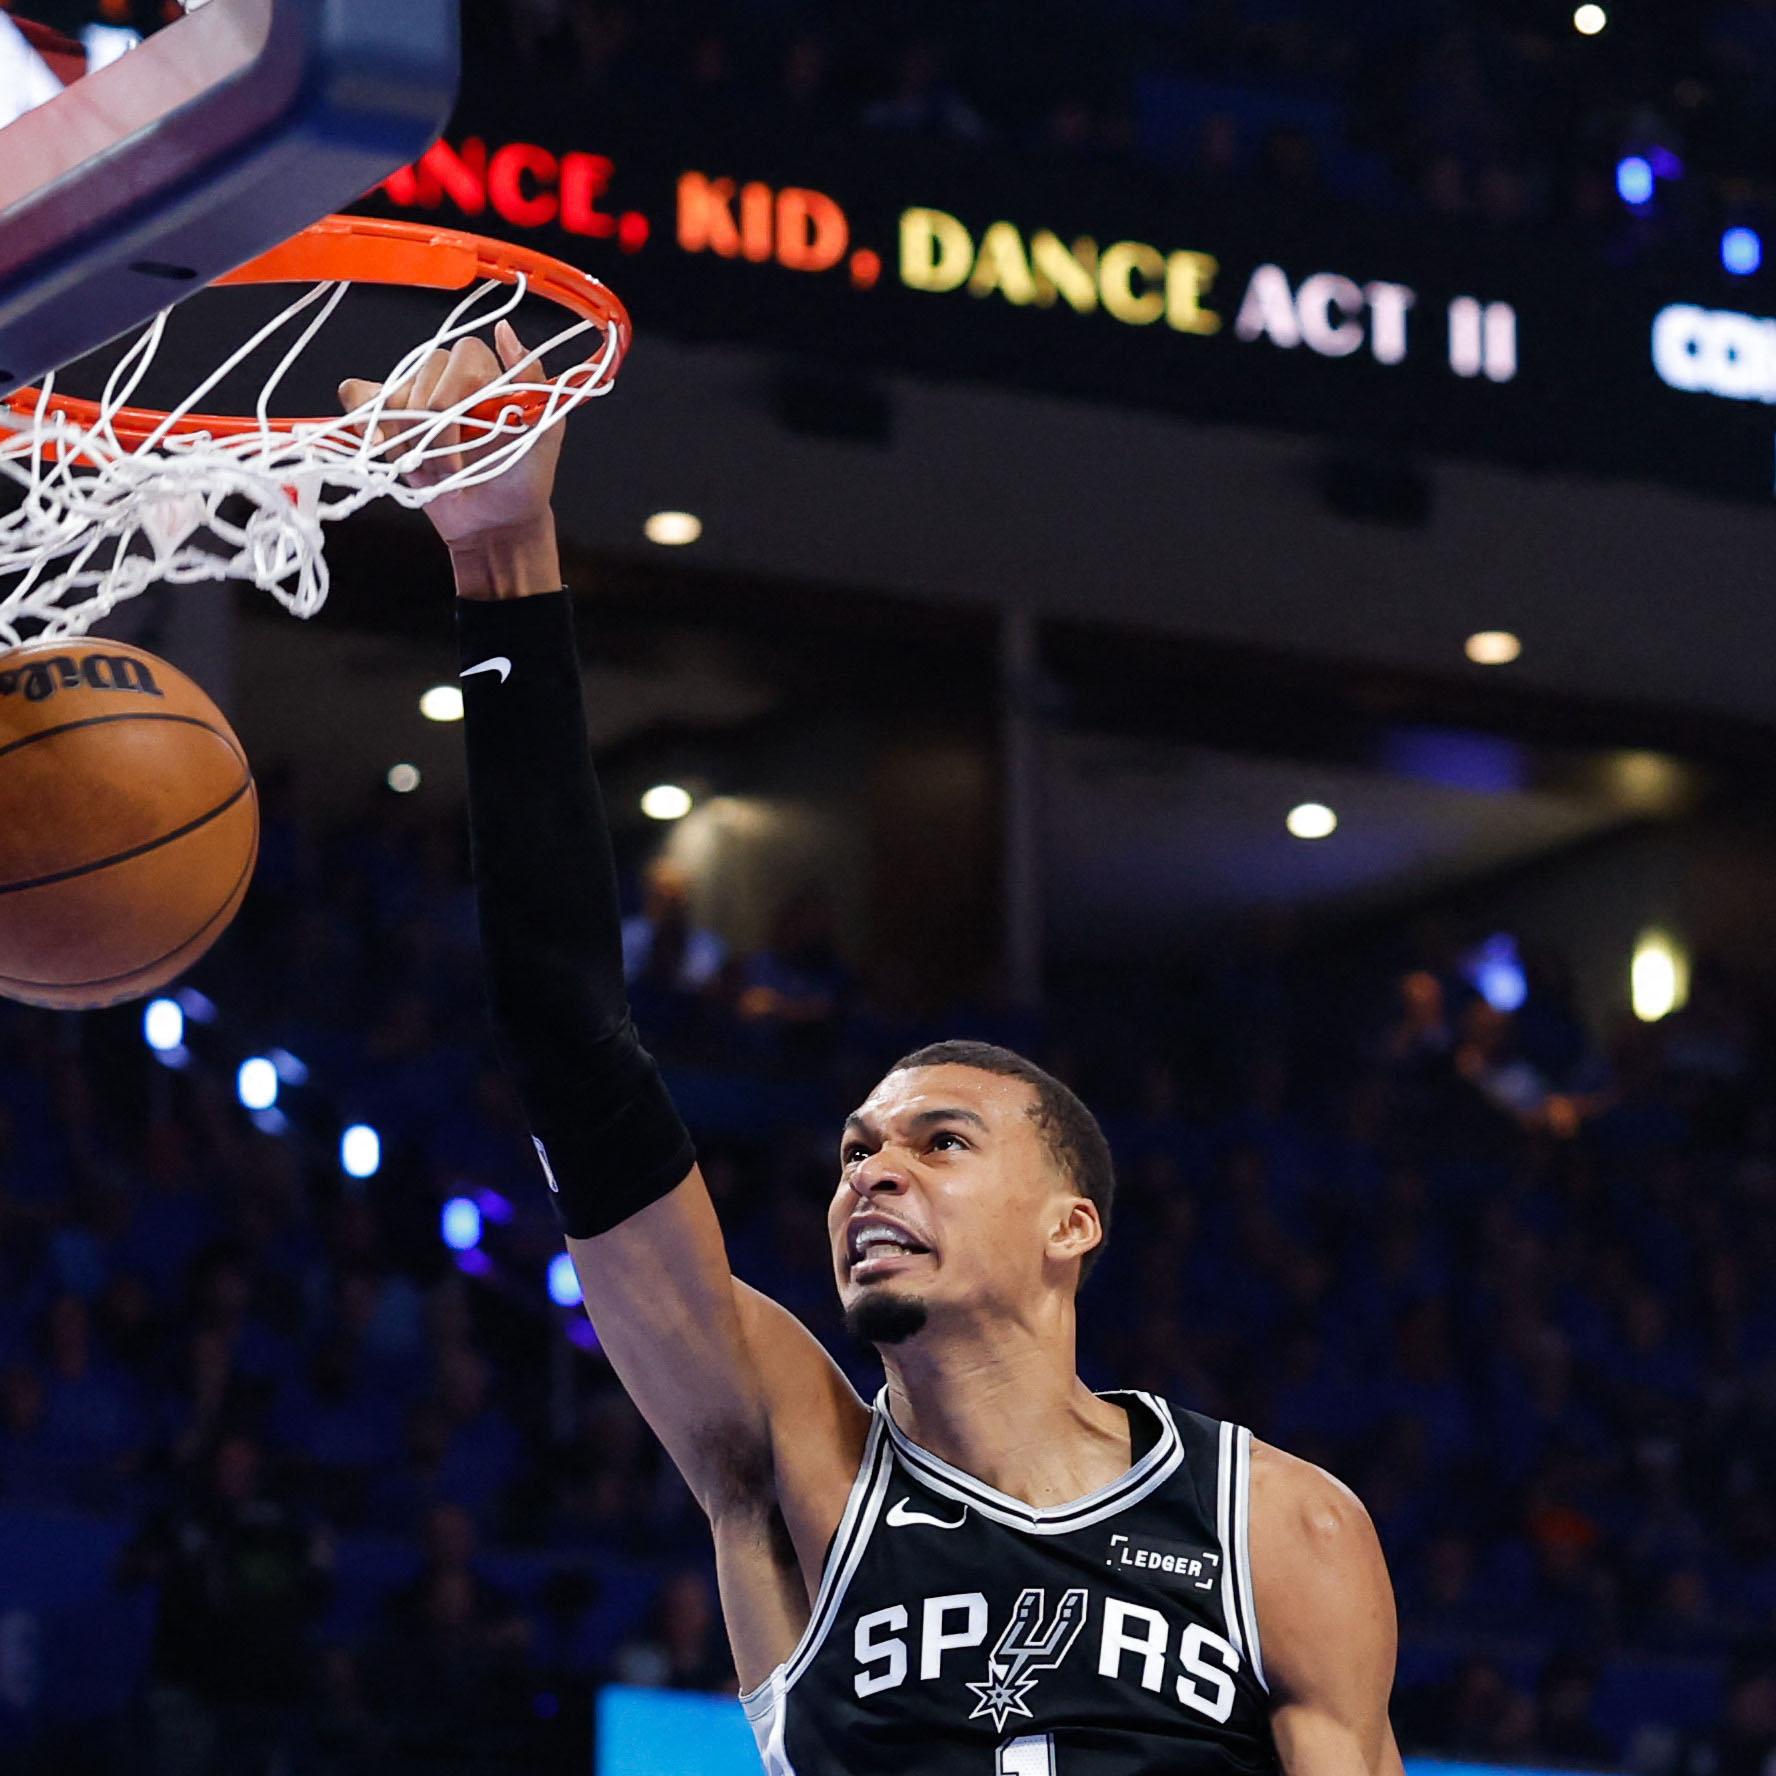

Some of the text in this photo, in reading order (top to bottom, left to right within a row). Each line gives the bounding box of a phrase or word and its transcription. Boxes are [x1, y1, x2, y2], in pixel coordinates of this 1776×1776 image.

[898, 205, 1222, 334] DANCE
[1236, 261, 1414, 364] ACT
[1120, 1547, 1203, 1577] LEDGER
[854, 1587, 1240, 1733] SPURS
